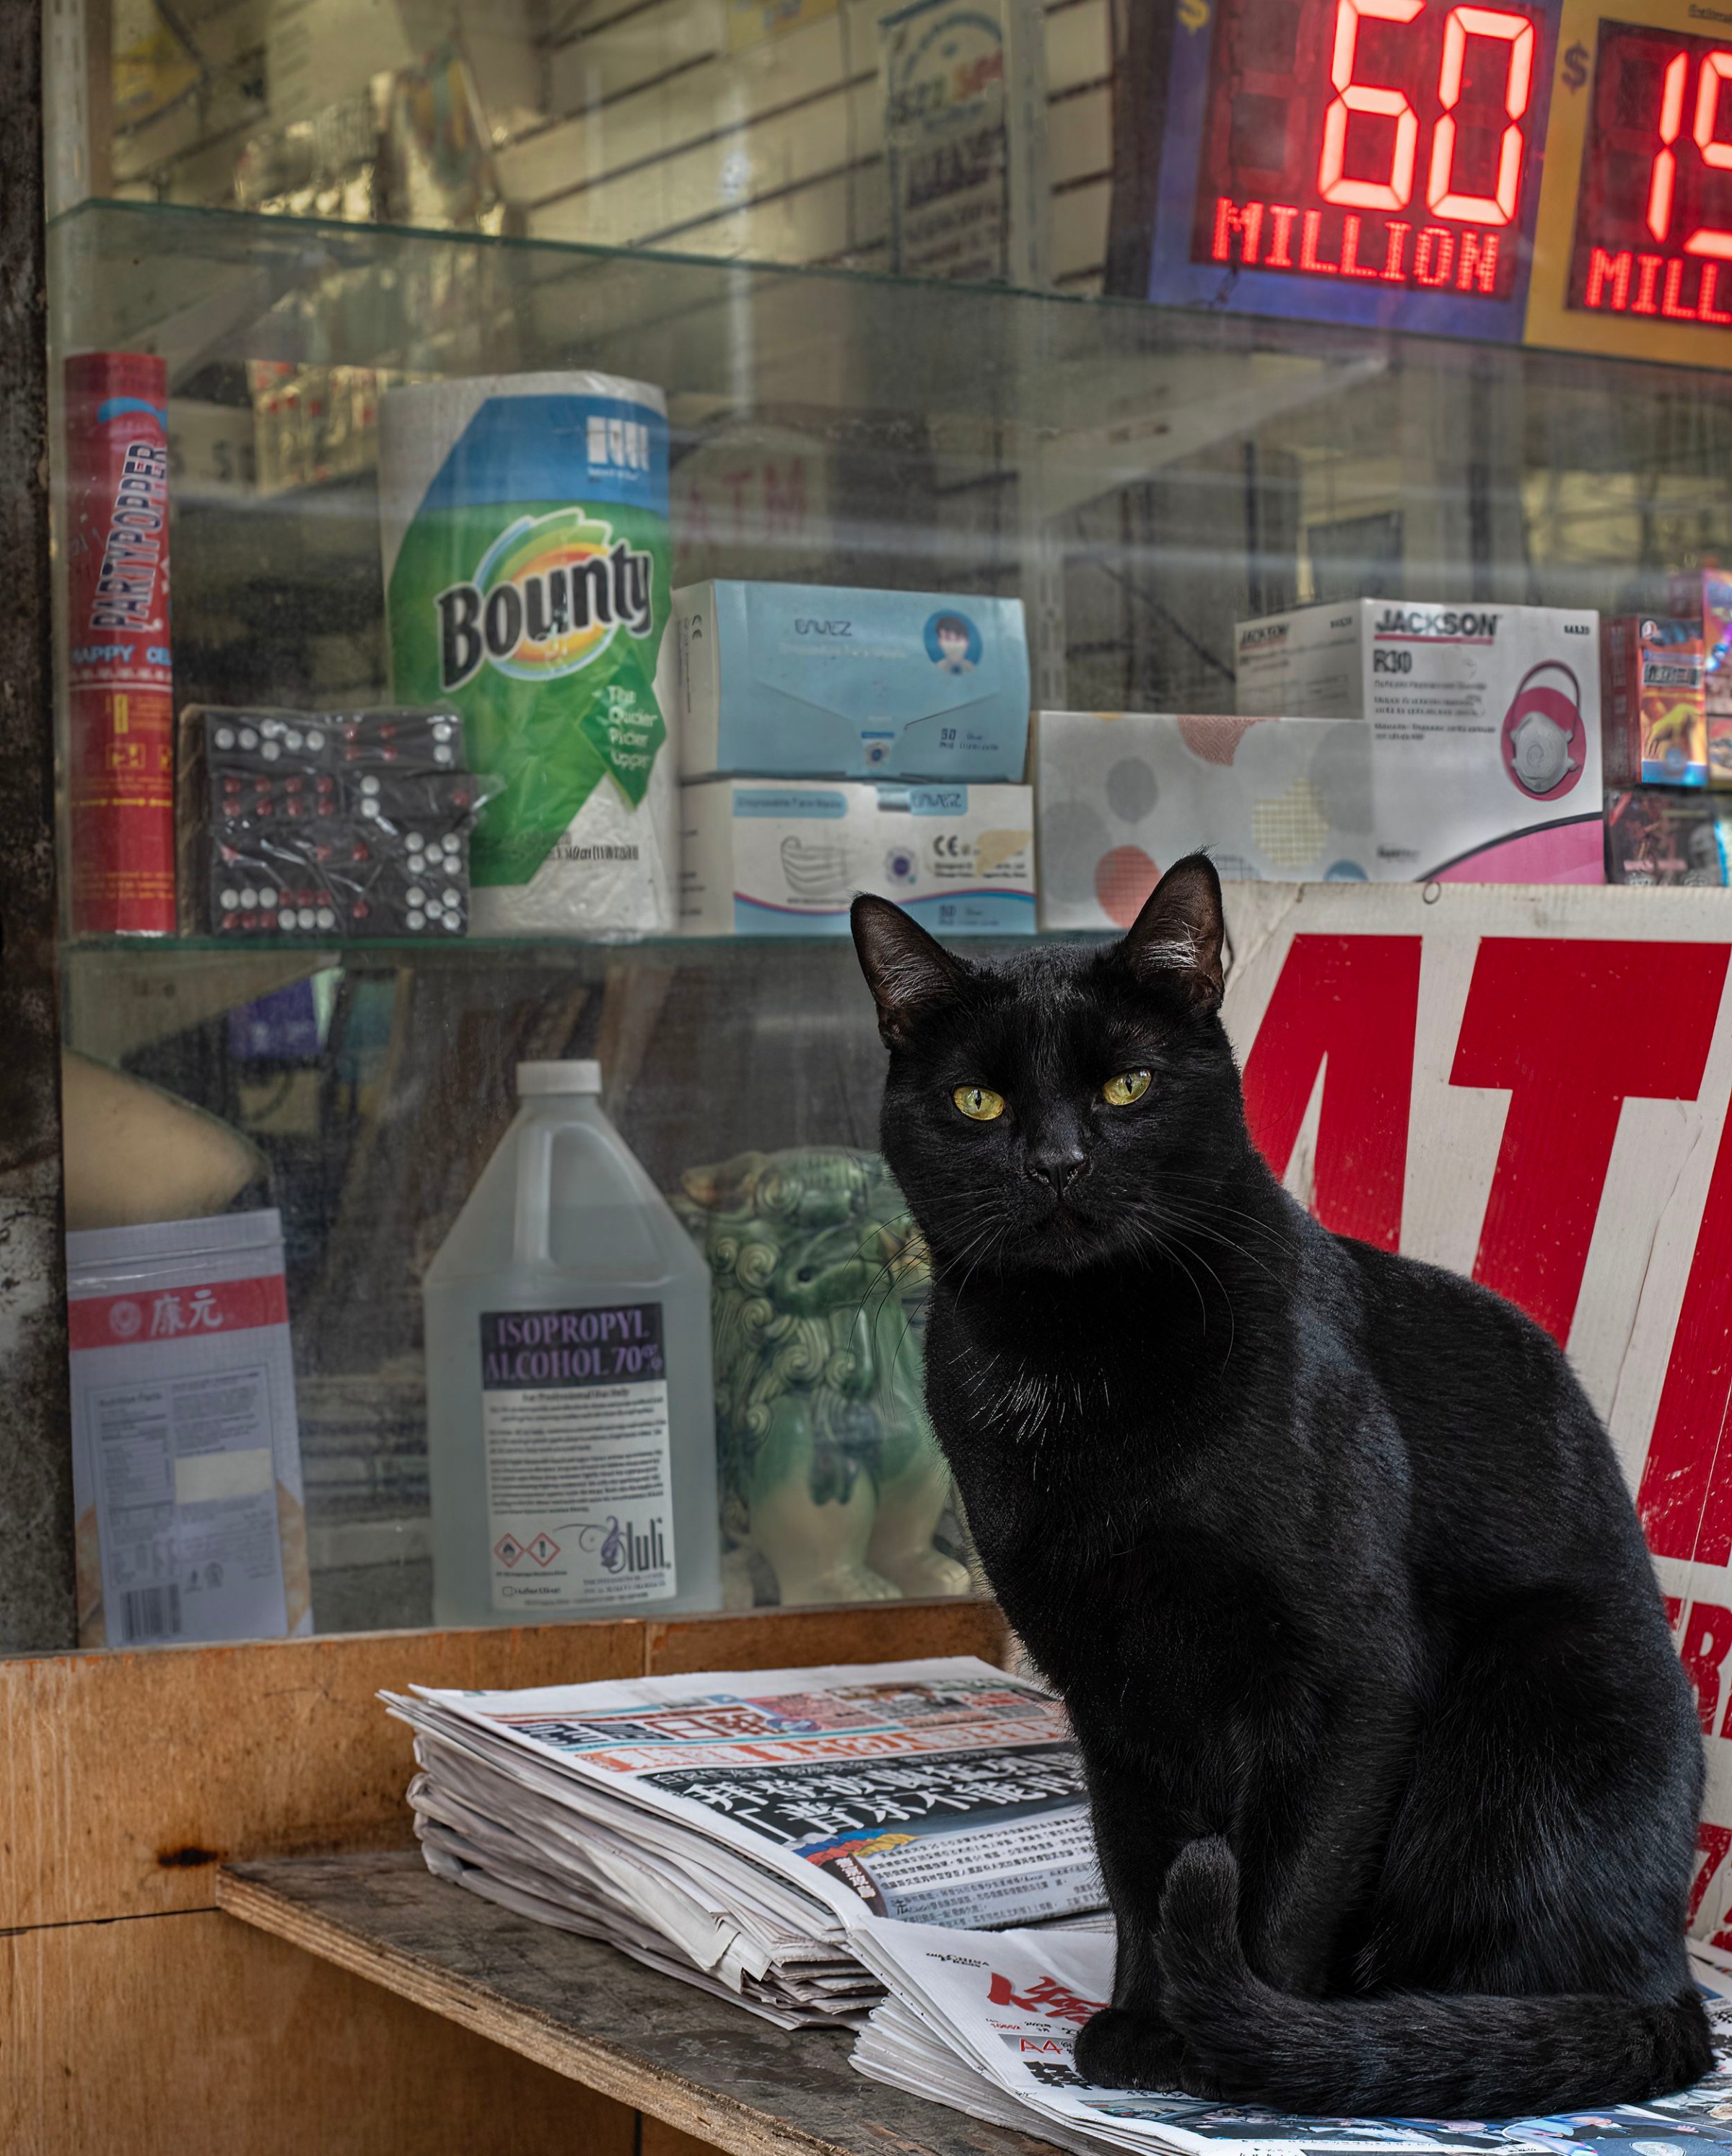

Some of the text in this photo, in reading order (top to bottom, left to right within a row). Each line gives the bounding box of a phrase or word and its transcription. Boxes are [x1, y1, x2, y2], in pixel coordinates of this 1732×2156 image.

[1560, 40, 1590, 95] $
[1318, 0, 1534, 226] 60
[1212, 197, 1500, 293] MILLION
[1584, 246, 1732, 325] MILL
[437, 538, 654, 691] Bounty
[1375, 610, 1497, 636] JACKSON
[71, 644, 136, 663] HAPPY
[1373, 649, 1412, 673] R30
[151, 1289, 224, 1336] 康元
[498, 1309, 650, 1346] ISOPROPYL
[486, 1343, 663, 1382] ALCOHOL 70%
[1020, 2037, 1064, 2055] A4
